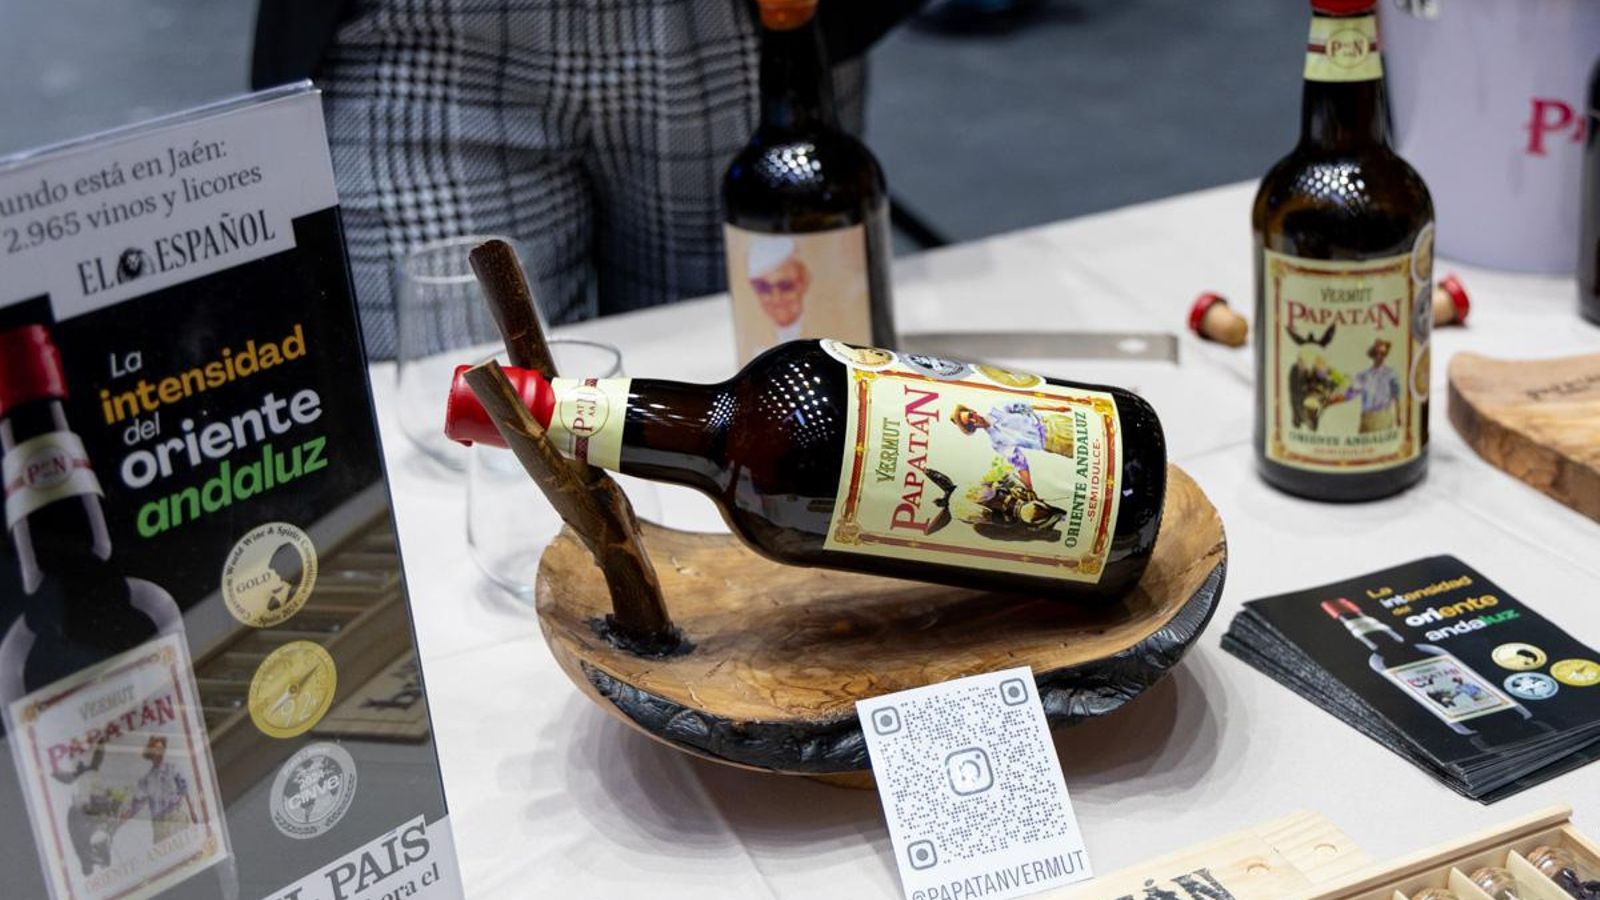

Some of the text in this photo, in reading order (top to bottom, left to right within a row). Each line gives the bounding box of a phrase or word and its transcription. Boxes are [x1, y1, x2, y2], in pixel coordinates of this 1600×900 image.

[75, 162, 125, 196] está
[132, 157, 163, 182] en
[169, 139, 227, 177] Jaén:
[3, 165, 263, 254] 2.965 vinos y licores
[76, 210, 276, 296] EL ESPAÑOL
[1320, 287, 1373, 302] VERMUT
[100, 324, 307, 425] intensidad
[110, 351, 143, 378] La
[120, 387, 323, 489] oriente
[123, 413, 161, 446] del
[875, 417, 901, 483] VERMUT
[137, 436, 328, 538] andaluz
[1064, 411, 1089, 548] ORIENTE ANDALUZ
[236, 572, 272, 593] GOLD
[1366, 586, 1393, 599] La
[1379, 575, 1473, 608] intensidad
[1404, 594, 1498, 627] oriente
[1425, 608, 1521, 641] andaluz
[421, 861, 440, 886] el
